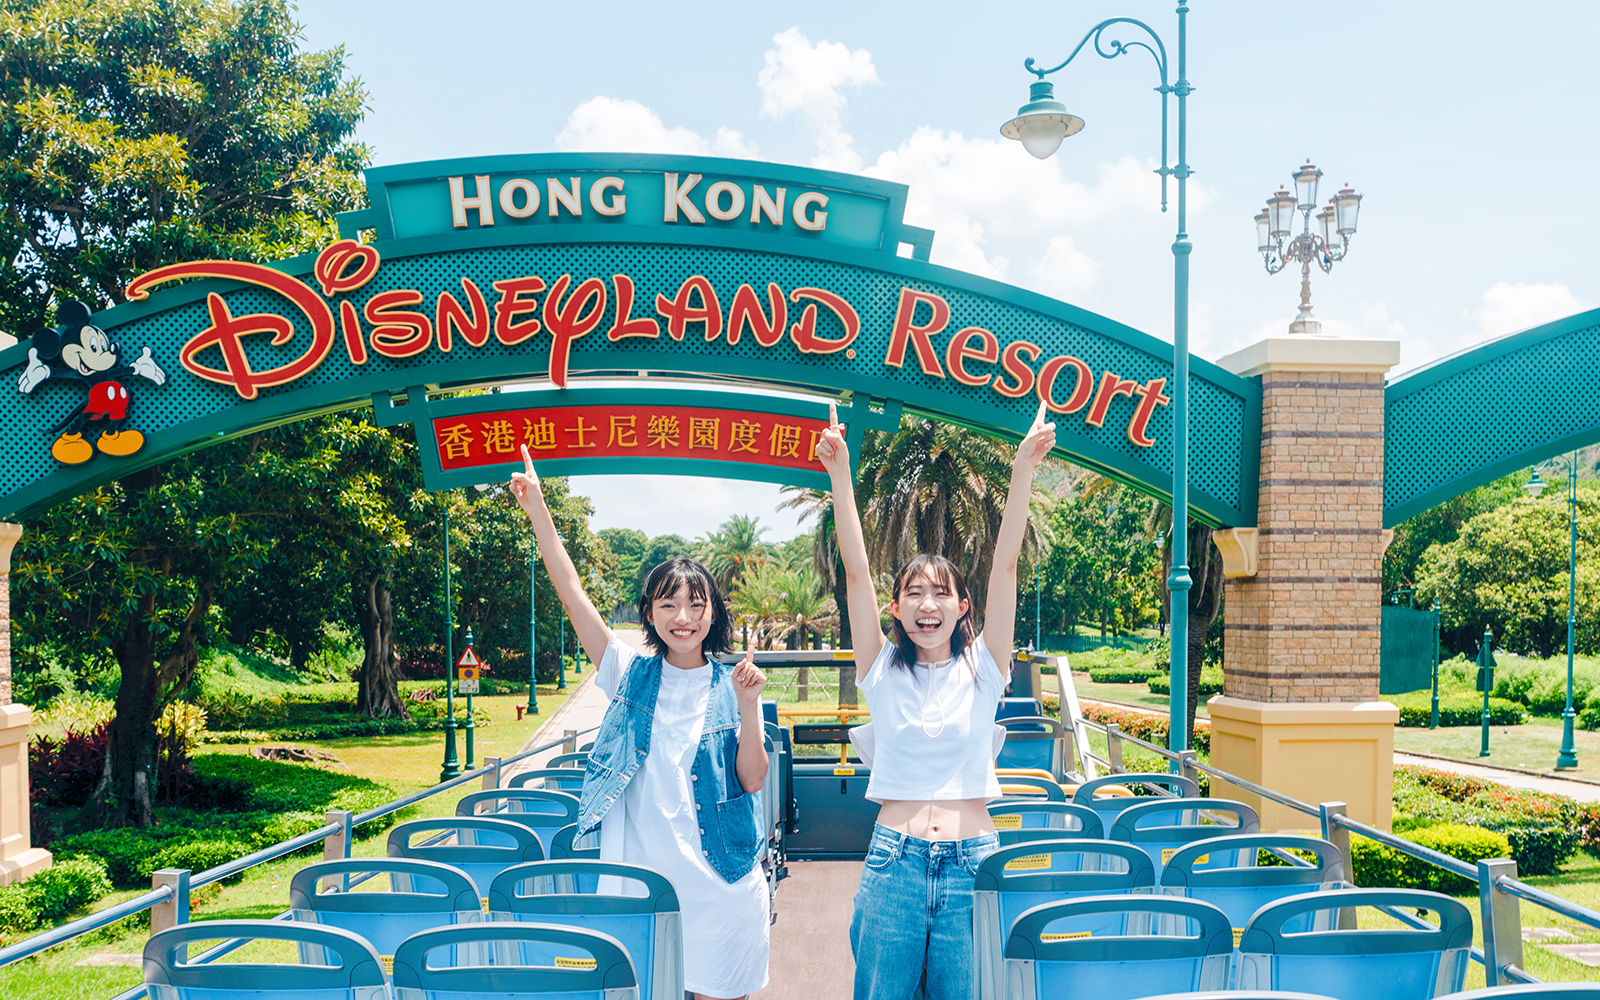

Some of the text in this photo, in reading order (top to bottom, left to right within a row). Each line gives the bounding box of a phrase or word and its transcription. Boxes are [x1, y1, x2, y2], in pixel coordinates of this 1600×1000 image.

[449, 172, 829, 231] HONG KONG
[885, 287, 1169, 447] Resort
